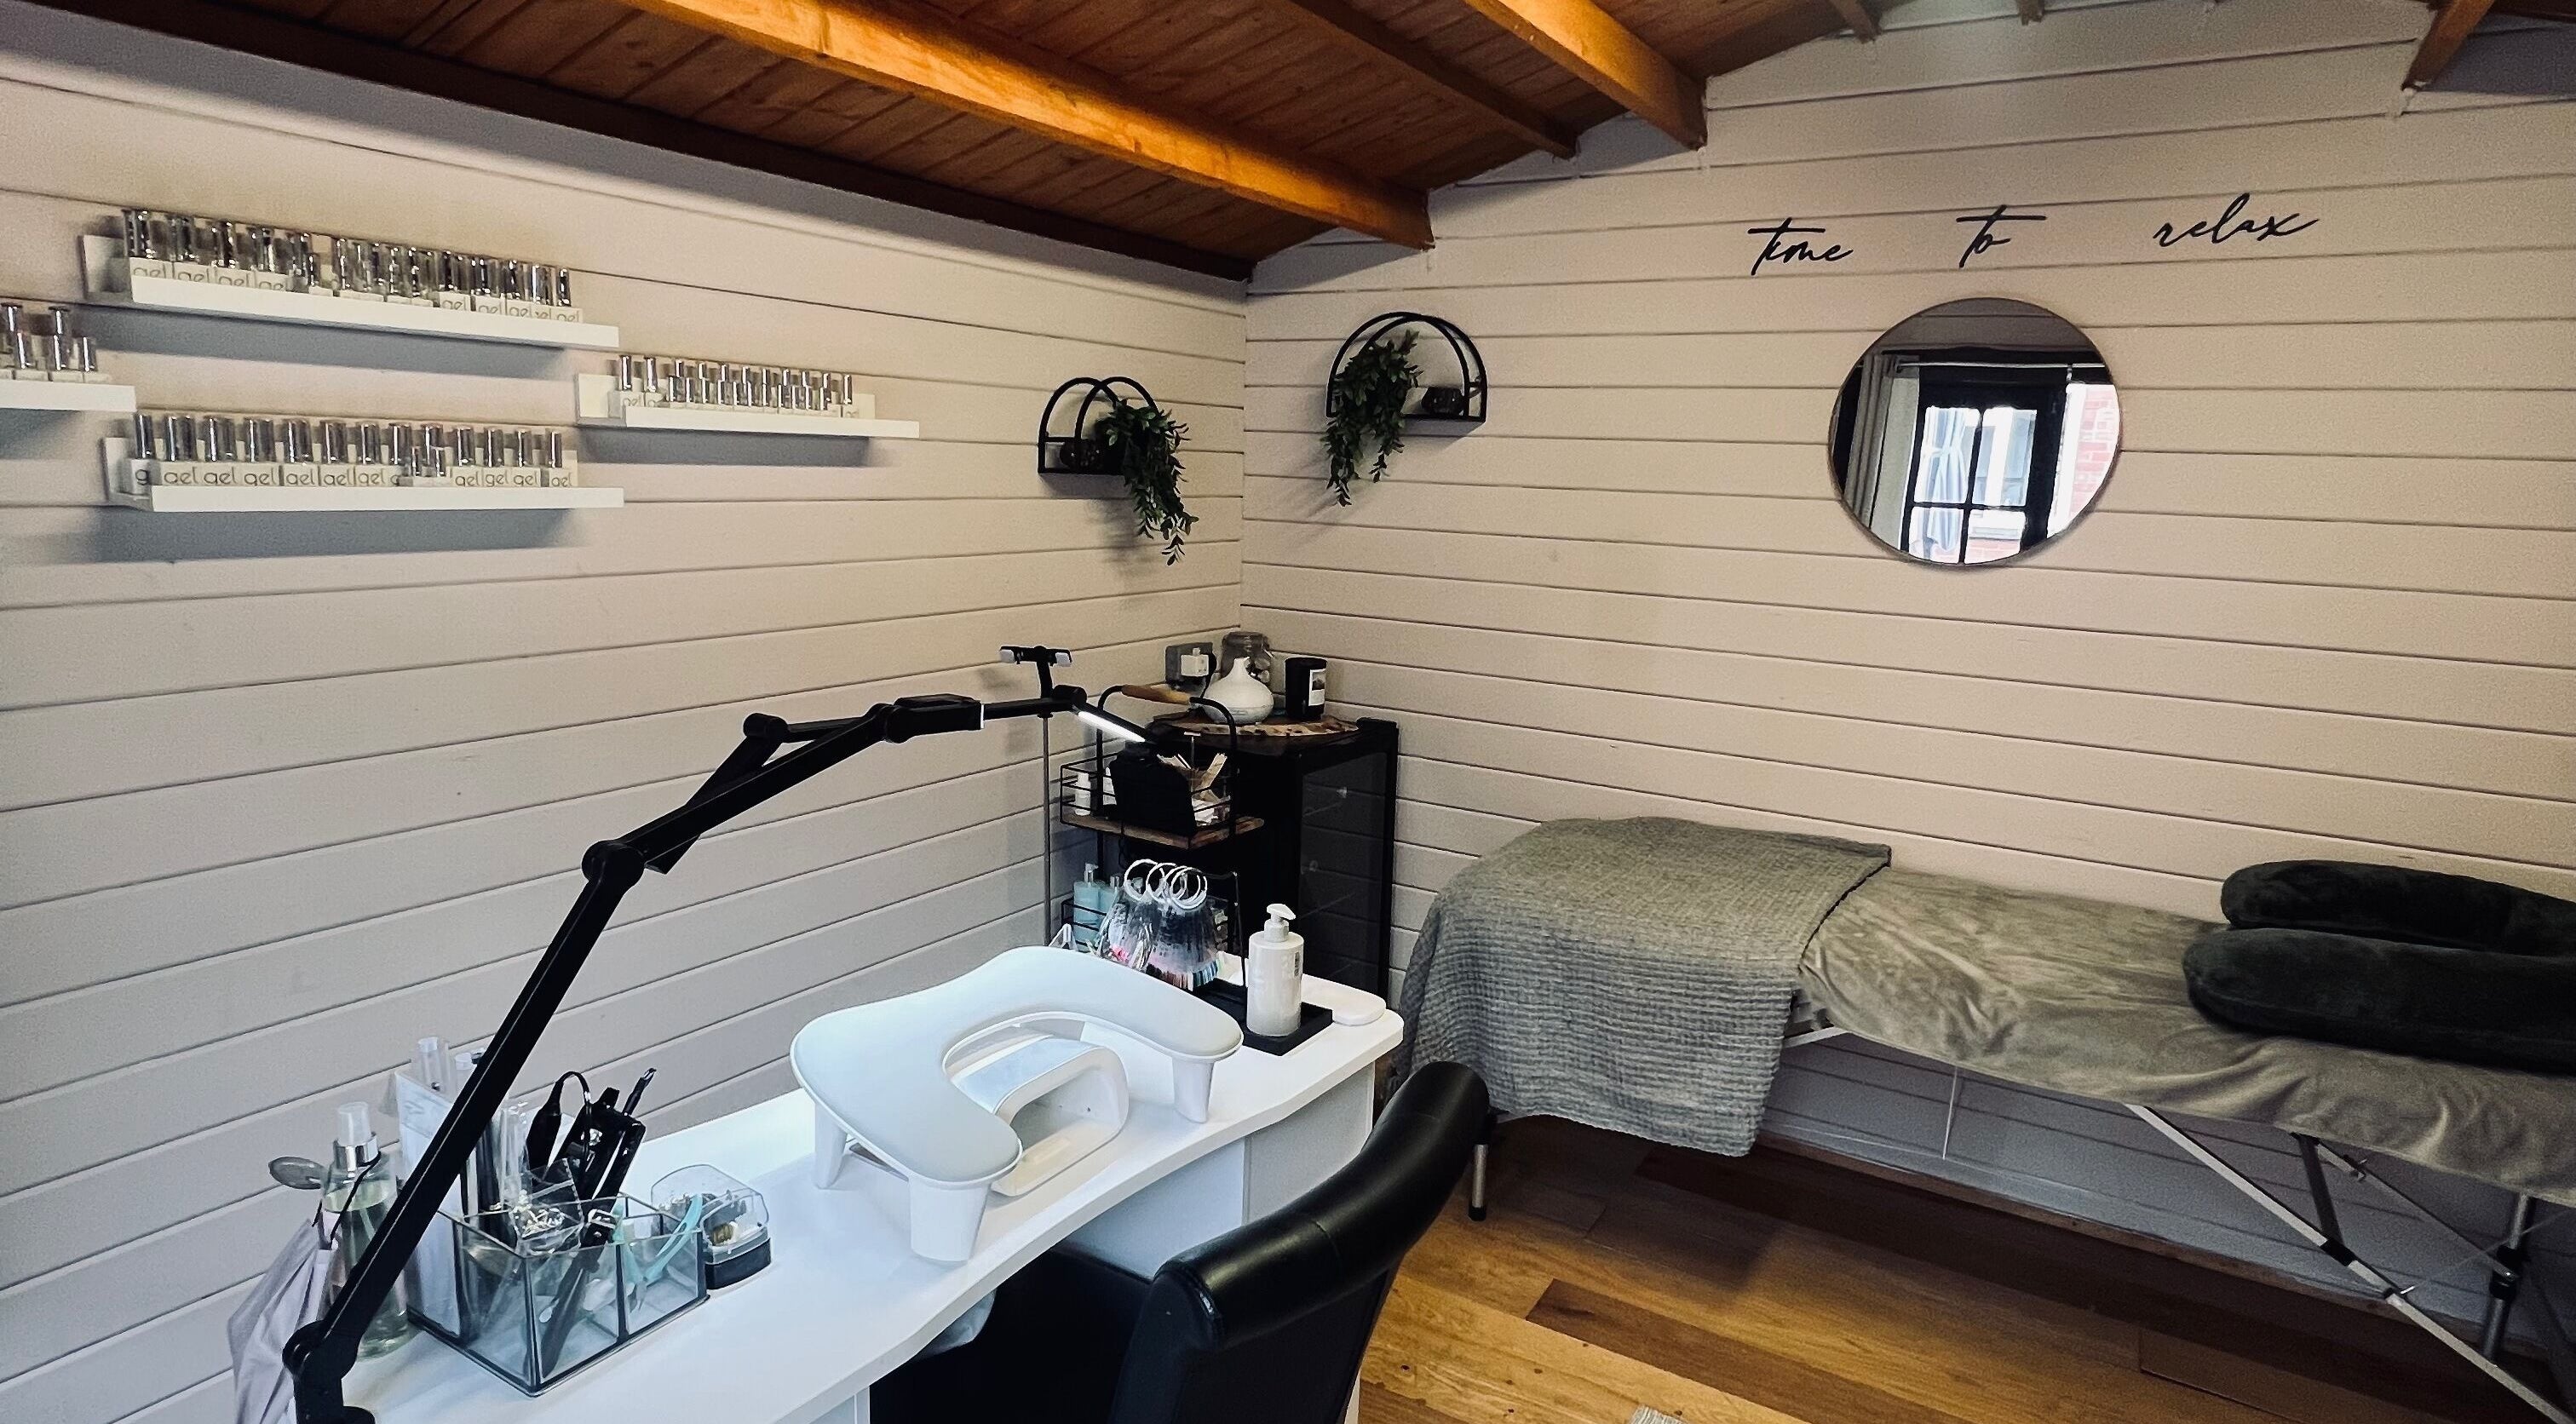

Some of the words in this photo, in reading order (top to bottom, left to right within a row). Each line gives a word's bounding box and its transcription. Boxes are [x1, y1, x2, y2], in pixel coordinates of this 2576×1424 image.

[1747, 216, 1854, 276] time
[1955, 204, 2048, 268] to
[2153, 192, 2320, 248] relax
